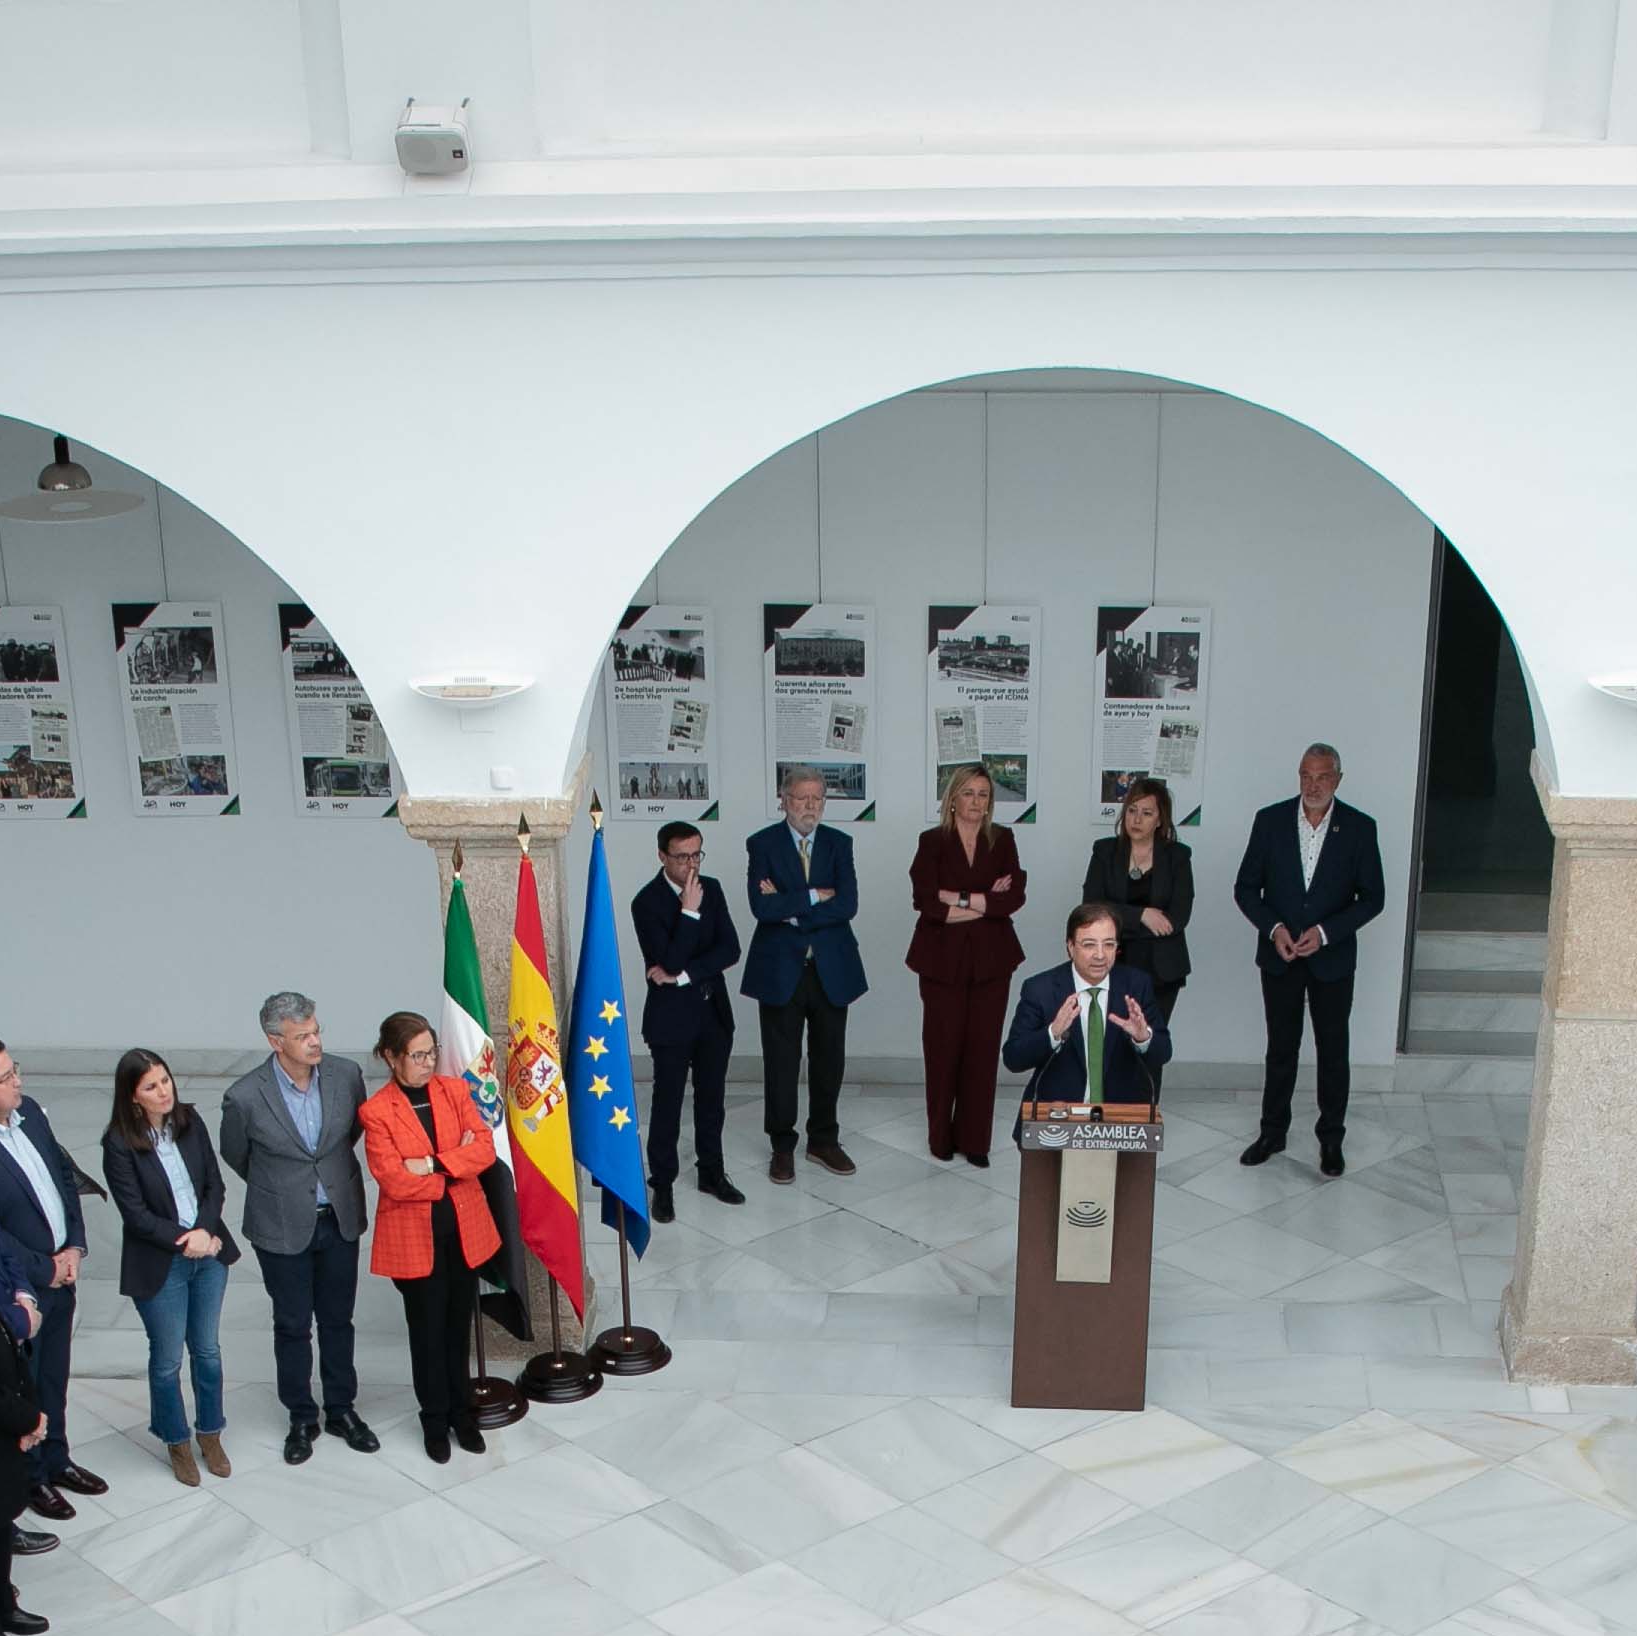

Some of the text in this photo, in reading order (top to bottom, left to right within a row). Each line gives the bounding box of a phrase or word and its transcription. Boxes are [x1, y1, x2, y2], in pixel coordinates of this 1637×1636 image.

[1073, 1125, 1147, 1140] ASAMBLEA
[1072, 1139, 1147, 1150] DE EXTREMADURA
